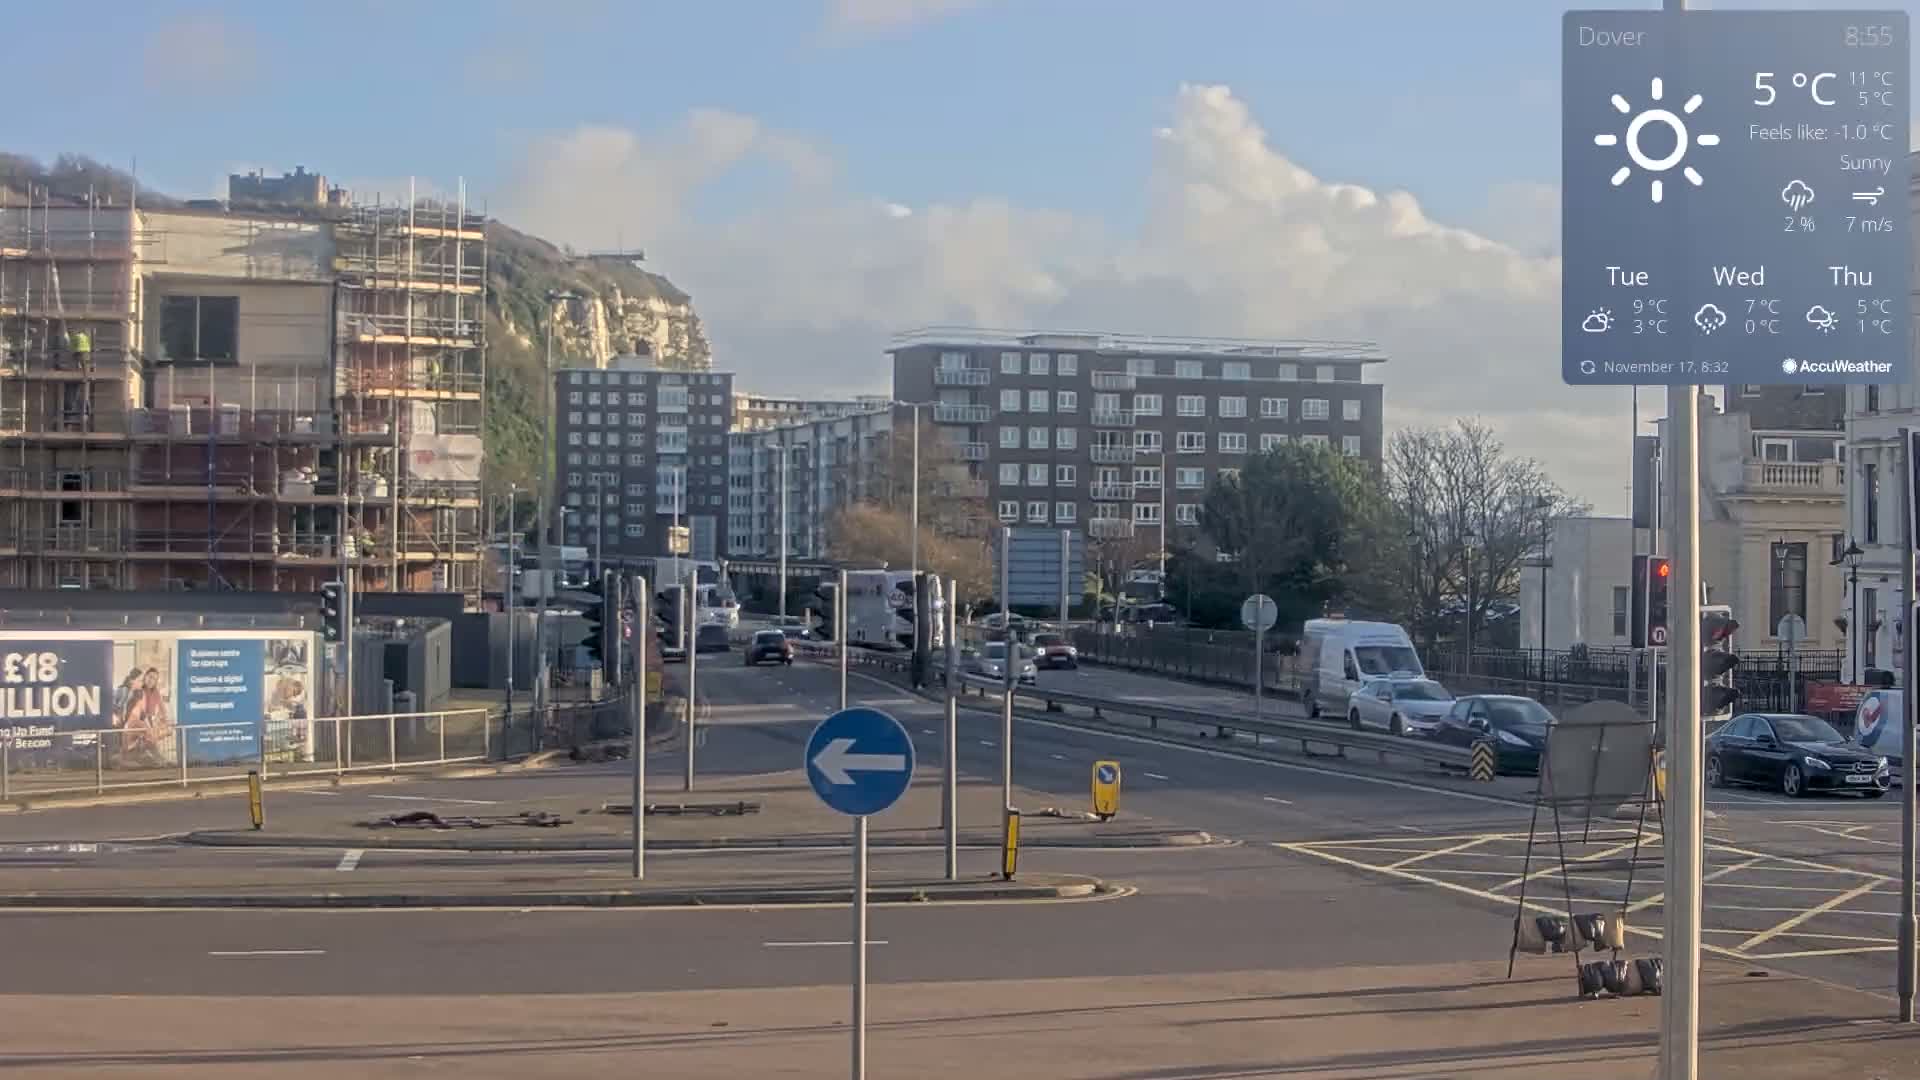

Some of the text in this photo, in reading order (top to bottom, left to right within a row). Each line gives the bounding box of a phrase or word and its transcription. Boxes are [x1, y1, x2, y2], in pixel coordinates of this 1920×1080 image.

[5, 652, 58, 683] £18
[12, 726, 28, 739] Up
[29, 725, 55, 737] Fund
[15, 738, 52, 749] Beacon
